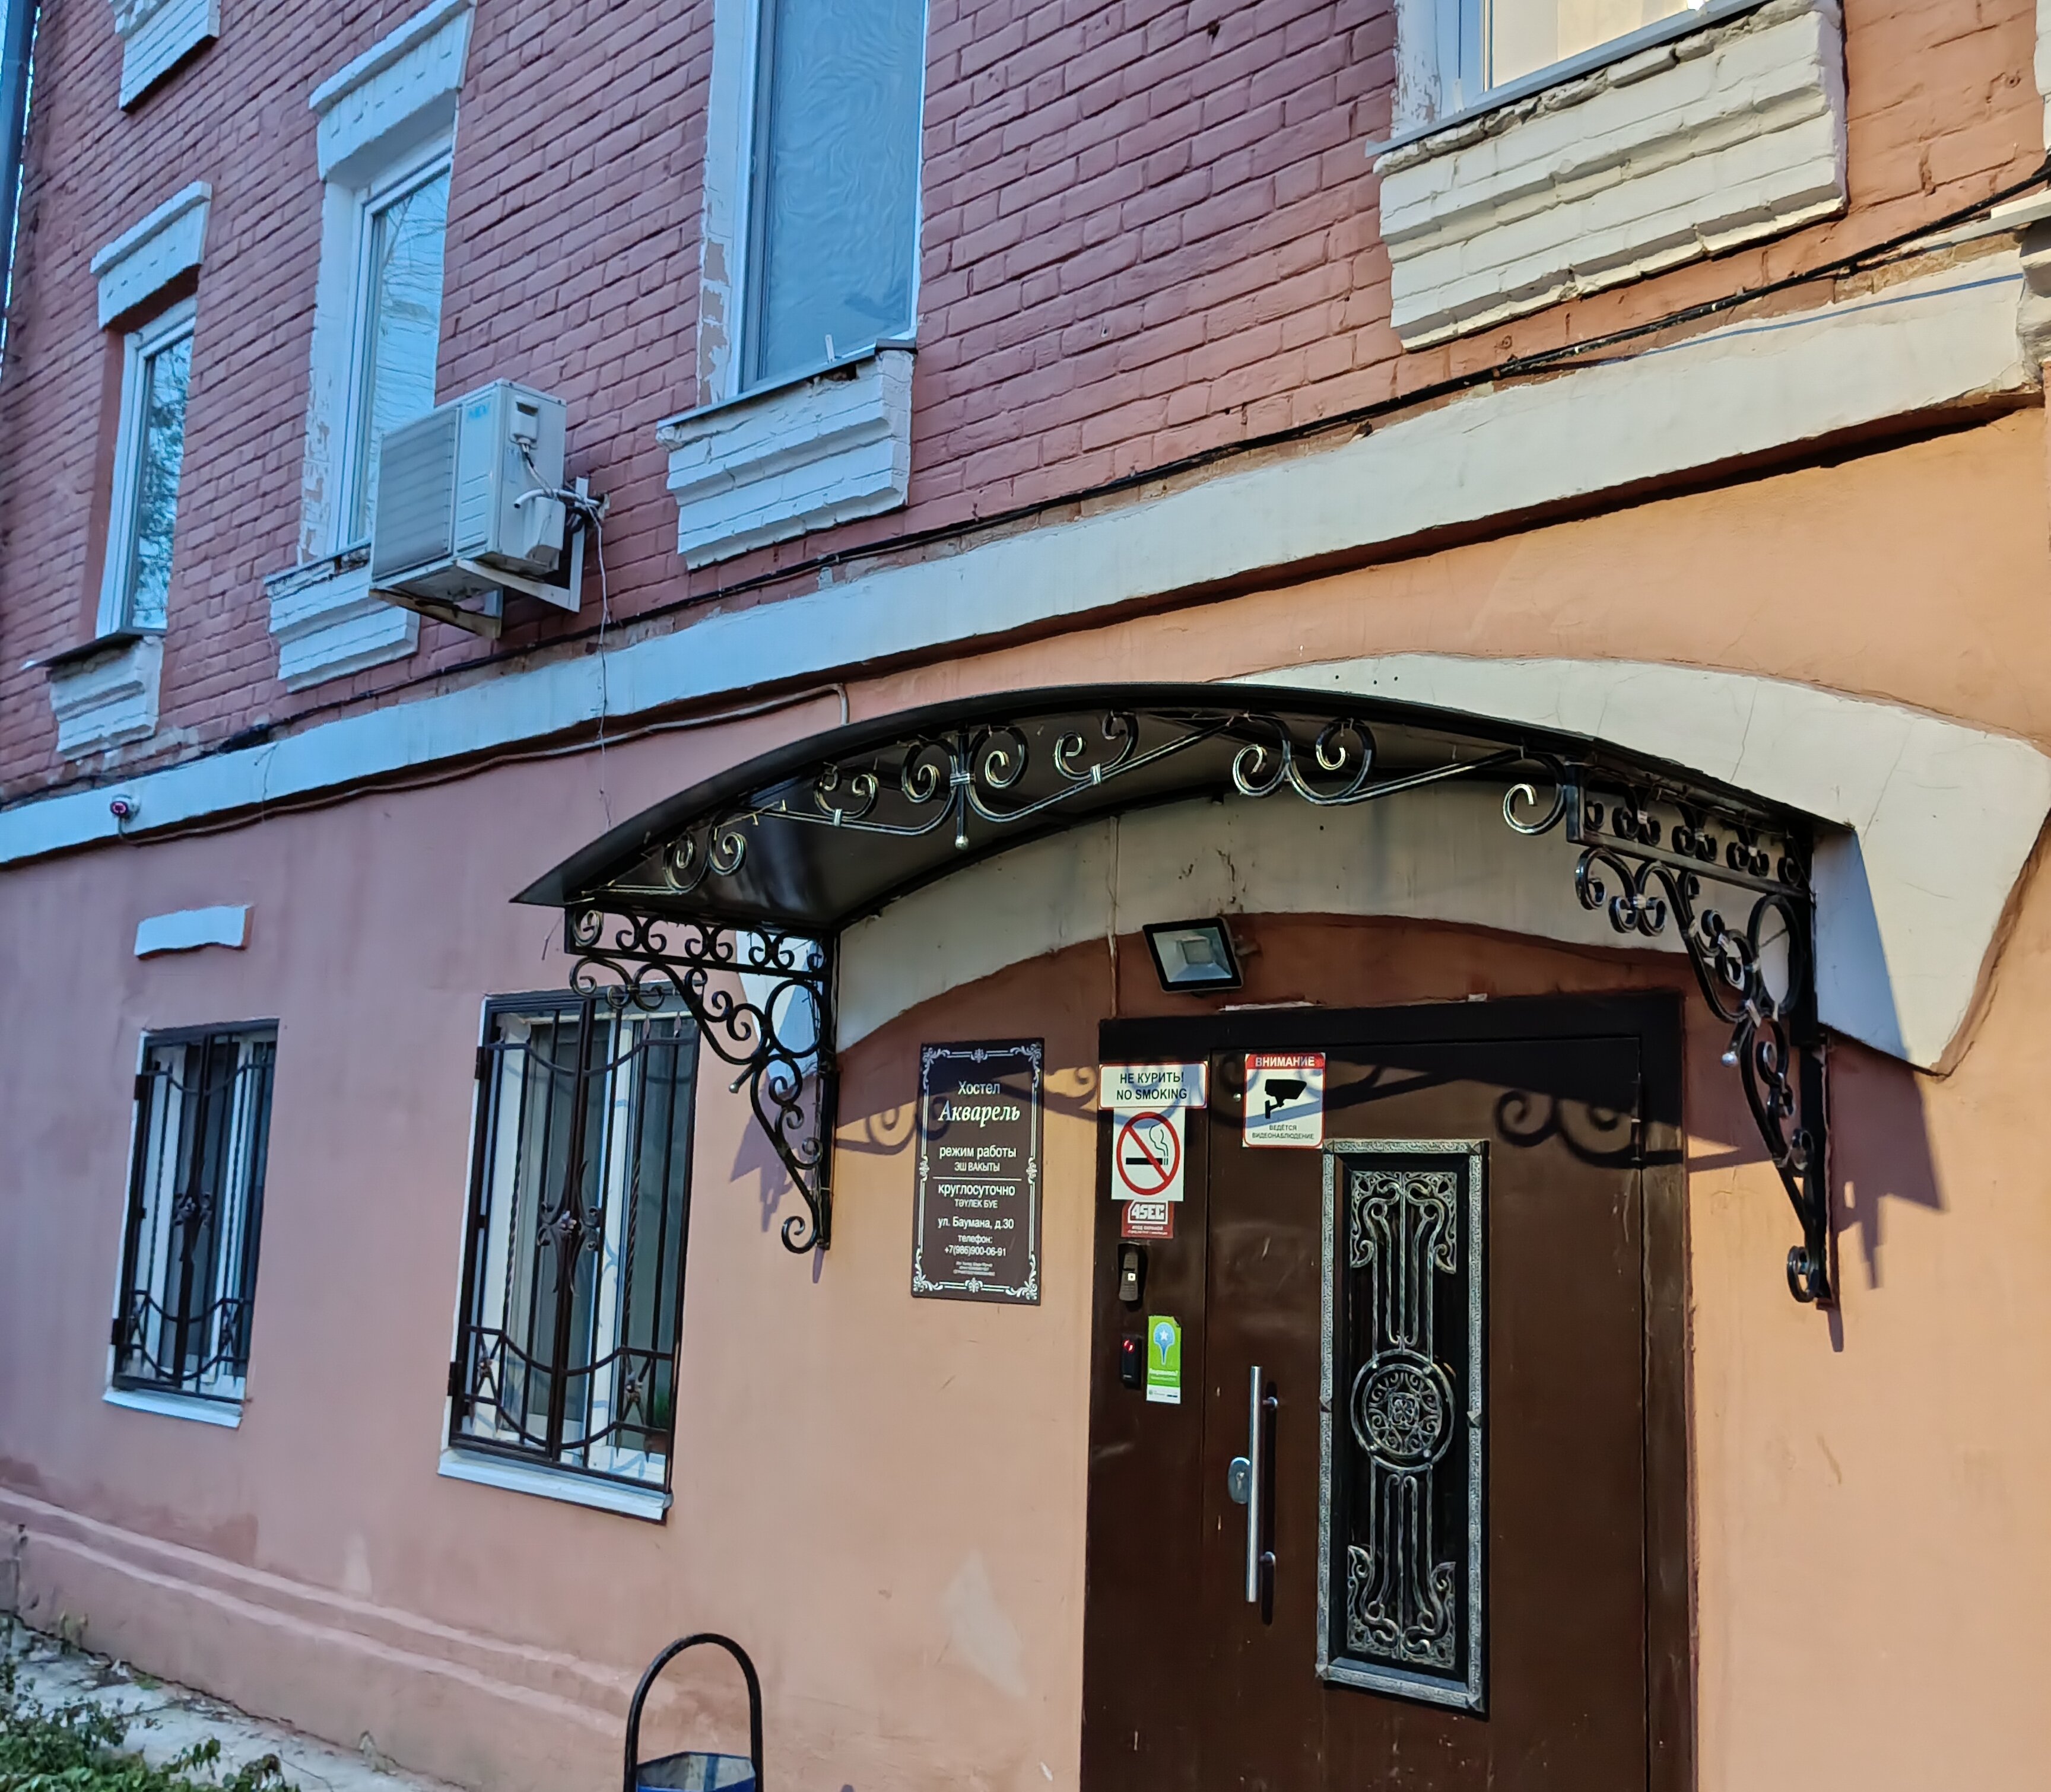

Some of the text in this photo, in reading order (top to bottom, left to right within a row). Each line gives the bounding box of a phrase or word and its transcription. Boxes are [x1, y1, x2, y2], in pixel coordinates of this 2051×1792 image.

[1255, 1056, 1315, 1067] ВНИМАНИЕ
[1120, 1072, 1184, 1084] НЕ КУРИТЬ!
[958, 1081, 1000, 1095] Хостел
[1116, 1088, 1188, 1100] NO SMOKING
[938, 1100, 1020, 1128] Акварель
[939, 1145, 1017, 1160] режим работы
[954, 1162, 1000, 1172] ЭШ ВАКЫТЫ
[938, 1184, 1015, 1198] круглосуточно
[983, 1200, 998, 1209] БУЕ
[1132, 1204, 1164, 1219] 4SEC
[938, 1216, 1014, 1229] ул. Баумана, д.30
[957, 1234, 993, 1244] телефон:
